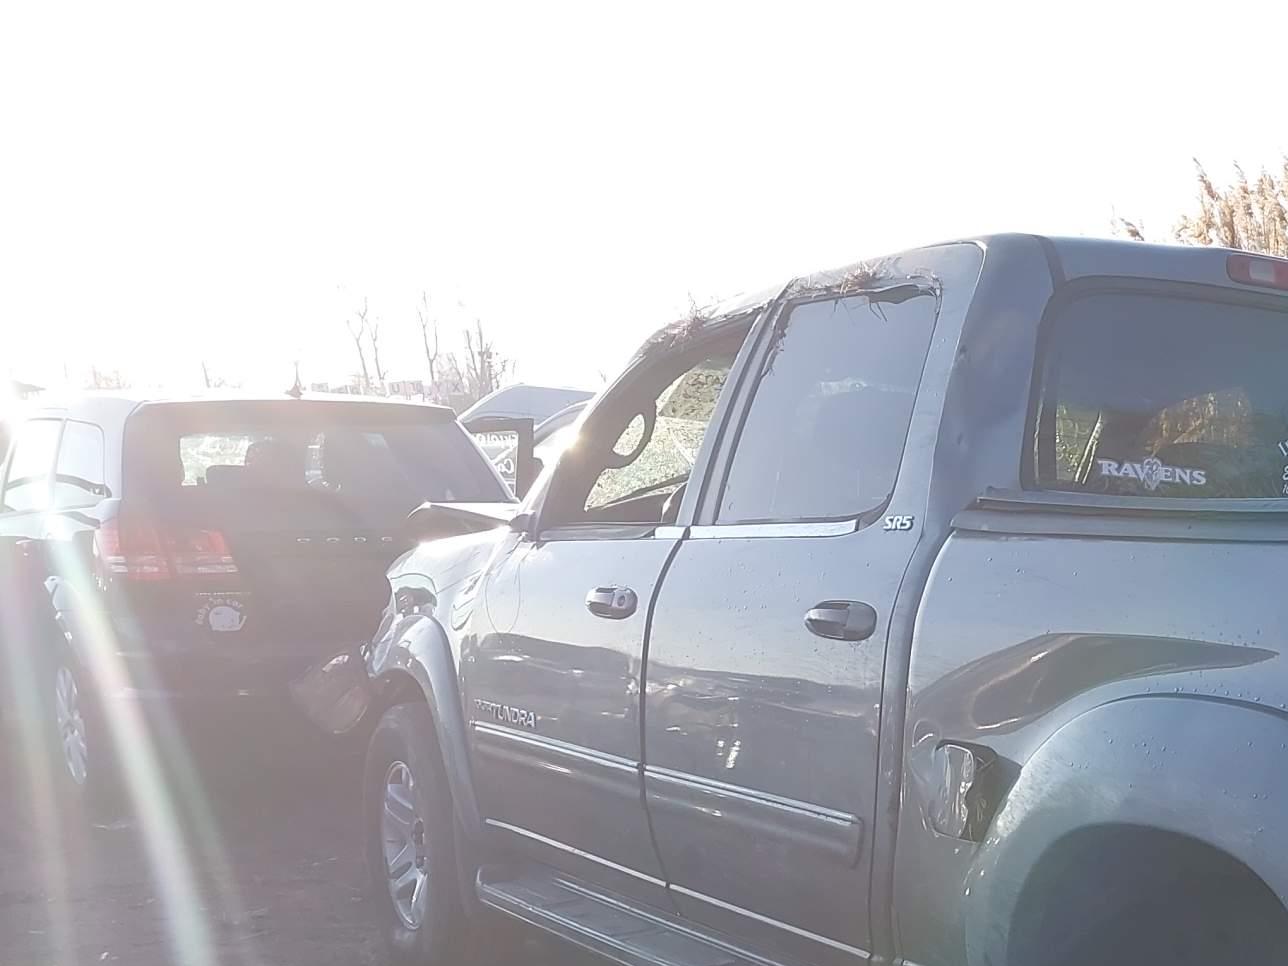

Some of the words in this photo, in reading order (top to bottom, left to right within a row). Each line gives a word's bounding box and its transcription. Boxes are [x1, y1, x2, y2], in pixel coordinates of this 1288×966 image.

[1097, 459, 1207, 486] RAVENS
[882, 515, 915, 532] SR5
[491, 703, 536, 728] TUNDRA
